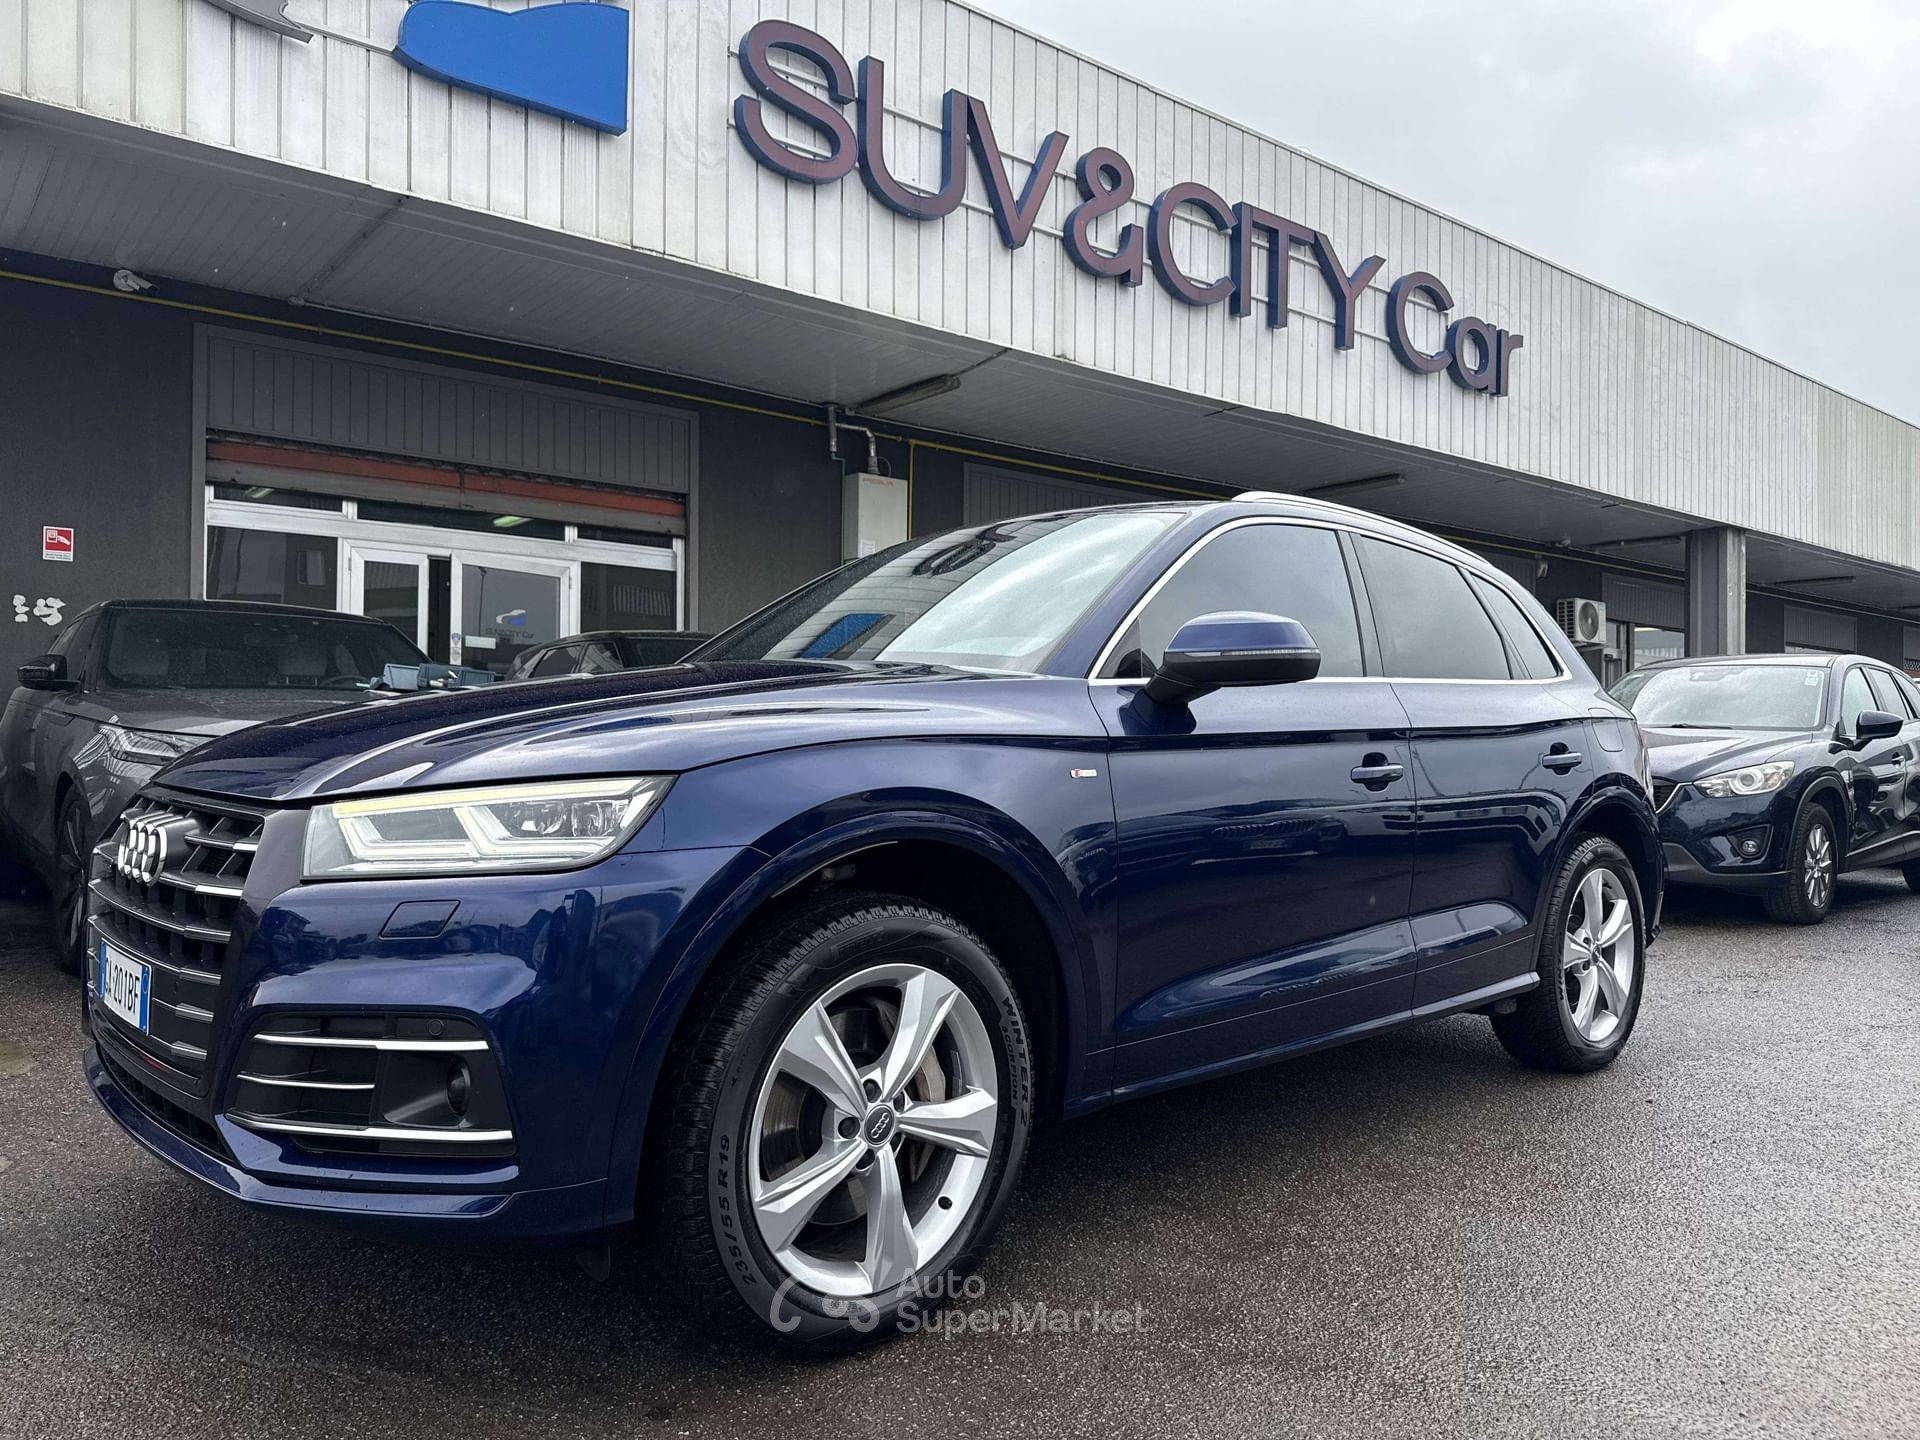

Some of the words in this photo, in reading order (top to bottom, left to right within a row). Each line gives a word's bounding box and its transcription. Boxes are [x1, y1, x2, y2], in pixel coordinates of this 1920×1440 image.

[734, 19, 1387, 351] SUV&CITY
[1385, 271, 1523, 397] Car
[1002, 996, 1029, 1104] WINTER
[717, 1134, 731, 1189] R19
[718, 1195, 758, 1286] 235/55
